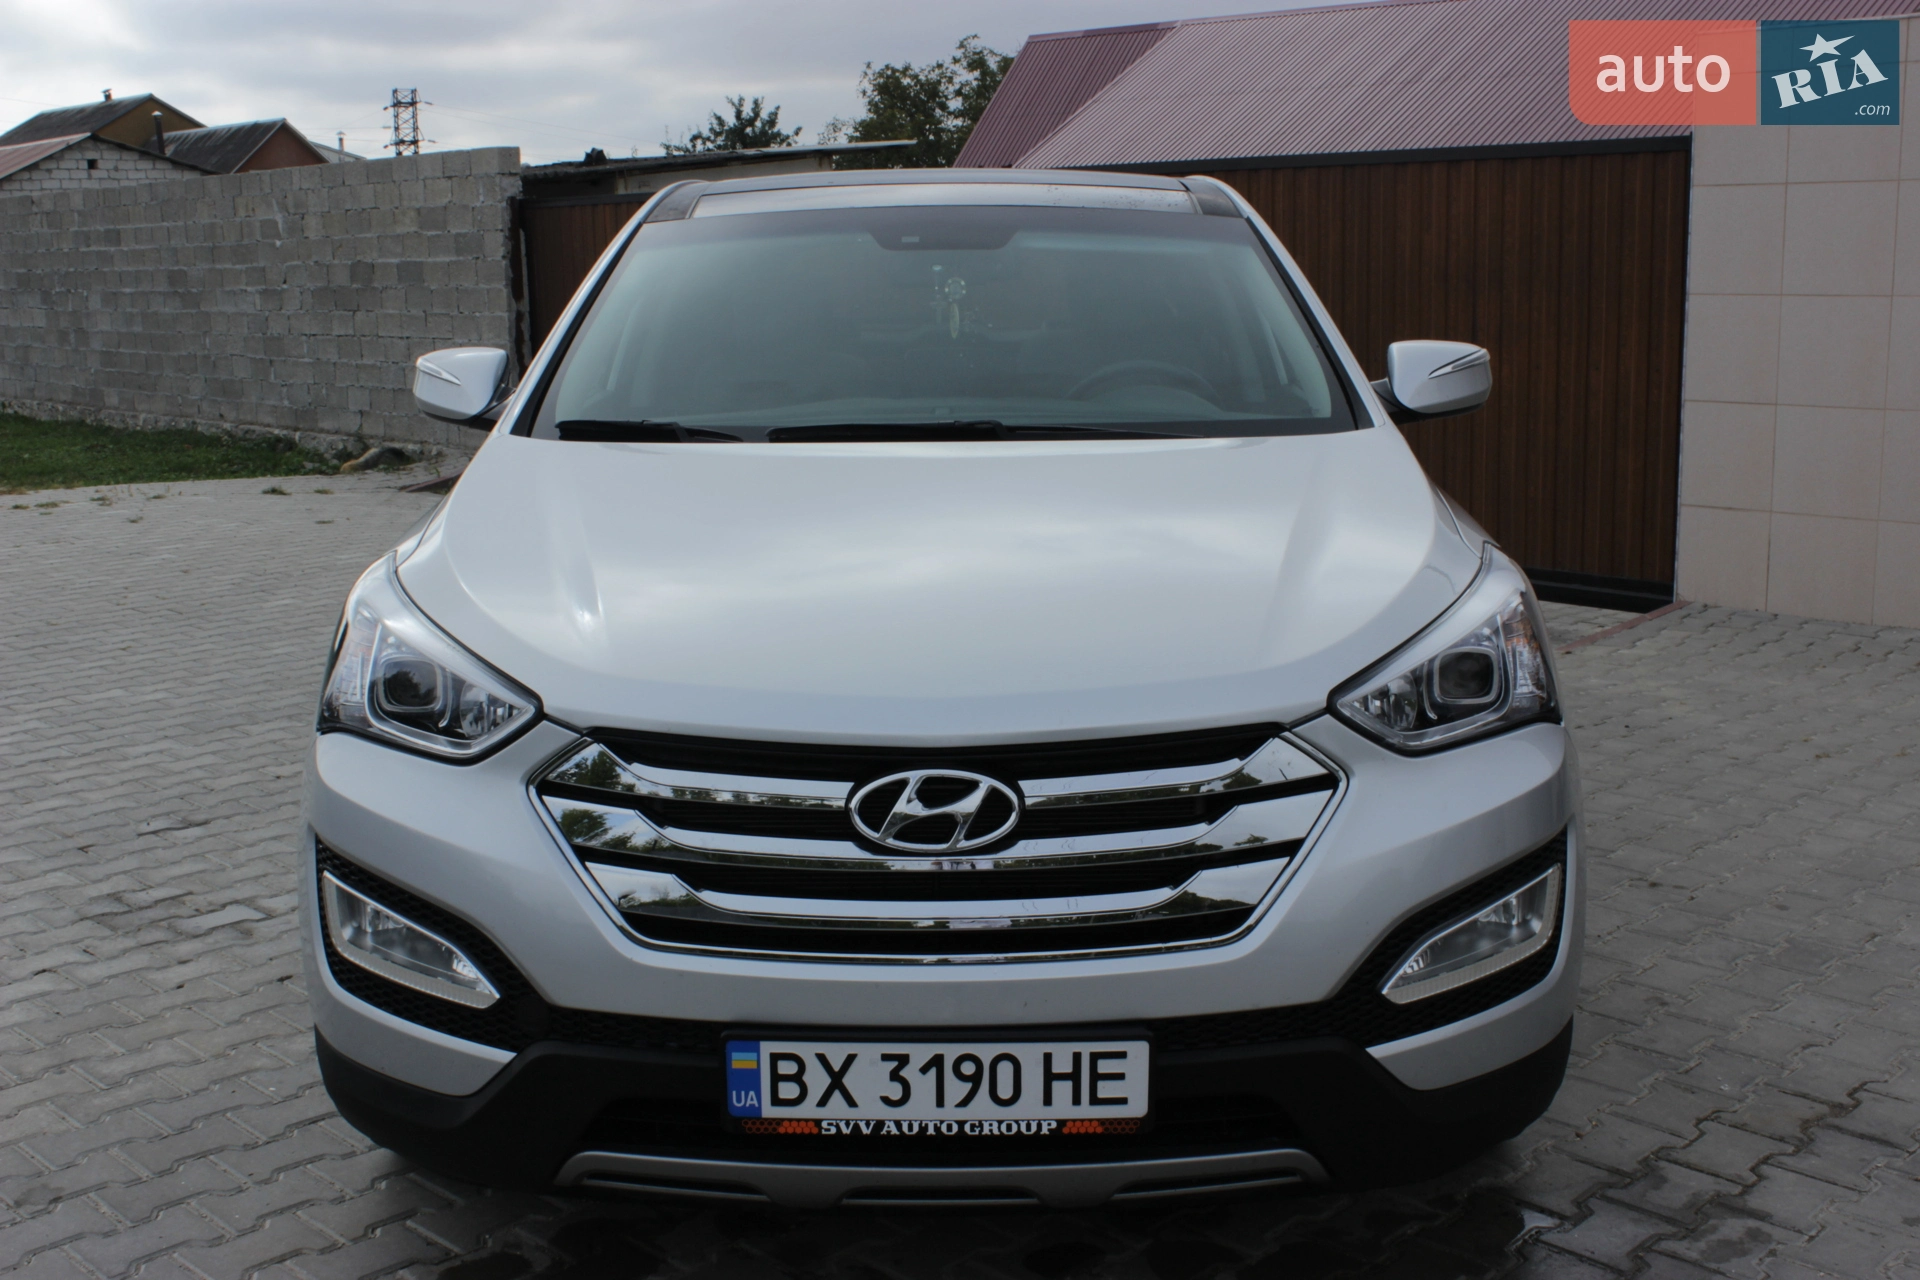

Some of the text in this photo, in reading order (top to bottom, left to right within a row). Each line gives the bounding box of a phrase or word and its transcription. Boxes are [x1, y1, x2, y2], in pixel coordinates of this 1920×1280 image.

[769, 1050, 1129, 1109] BX 3190 HE
[732, 1090, 759, 1108] UA
[821, 1119, 1058, 1136] SVV AUTO GROUP
